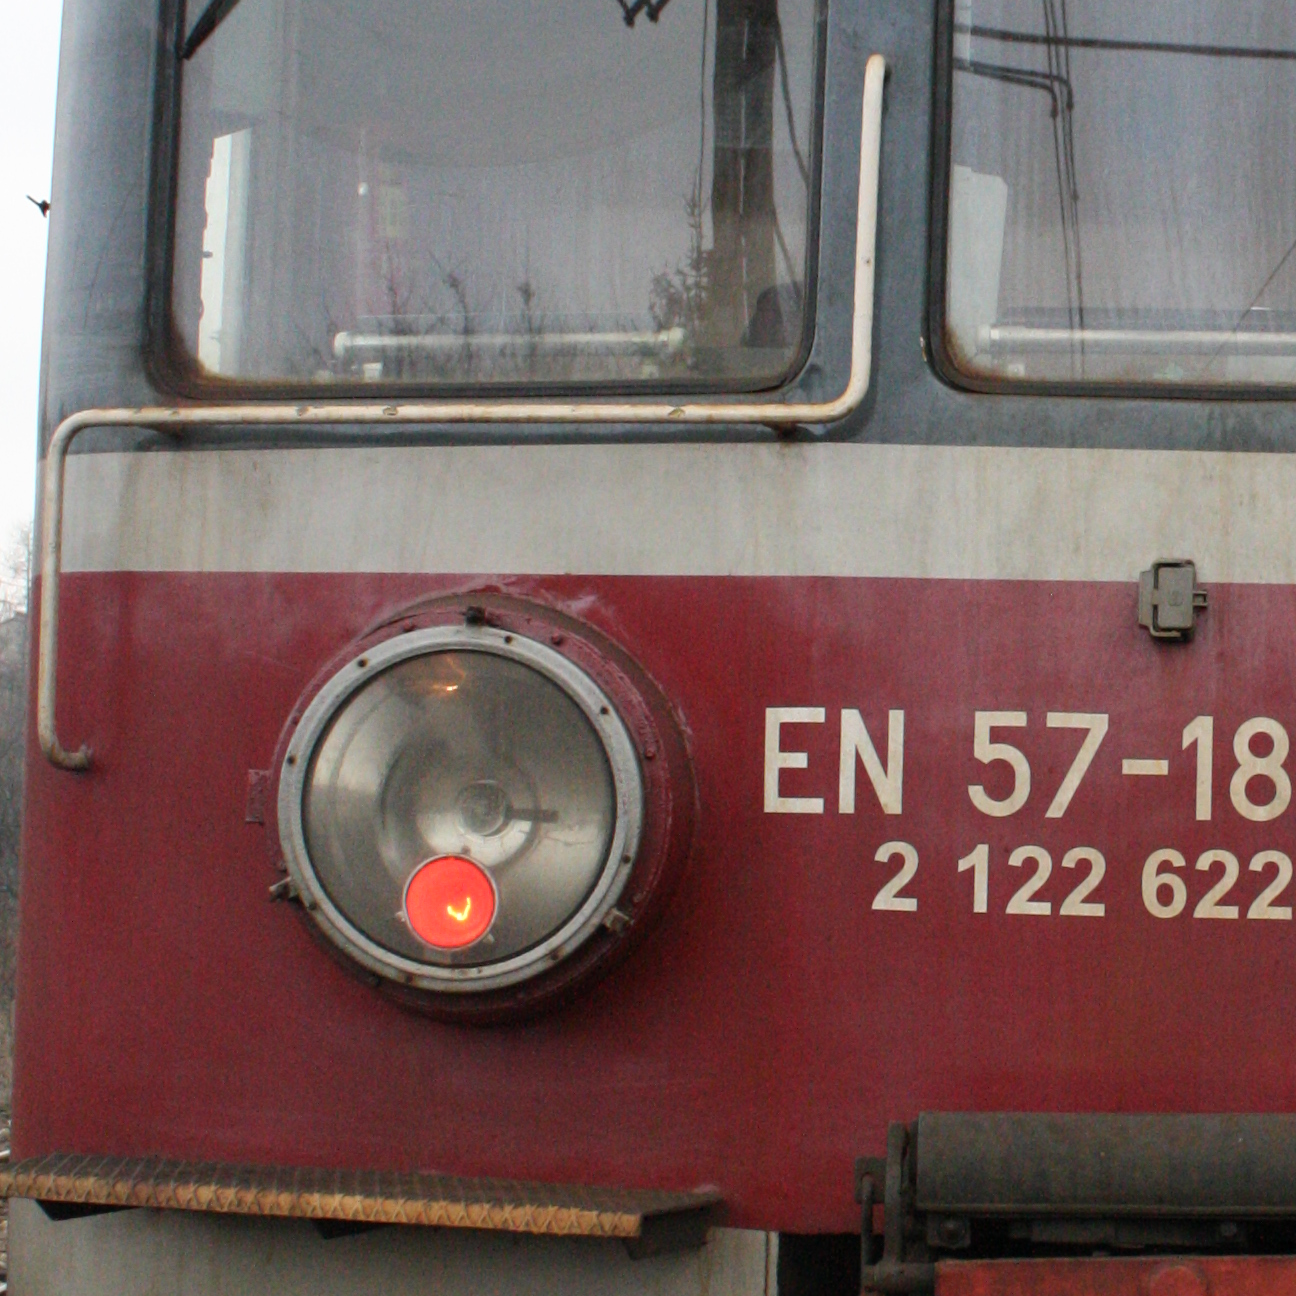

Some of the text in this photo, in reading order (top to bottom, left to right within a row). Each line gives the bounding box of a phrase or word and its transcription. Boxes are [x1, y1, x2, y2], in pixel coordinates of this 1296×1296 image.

[763, 706, 905, 815] EN
[871, 840, 919, 912] 2
[956, 843, 1107, 917] 122
[1141, 847, 1294, 921] 622
